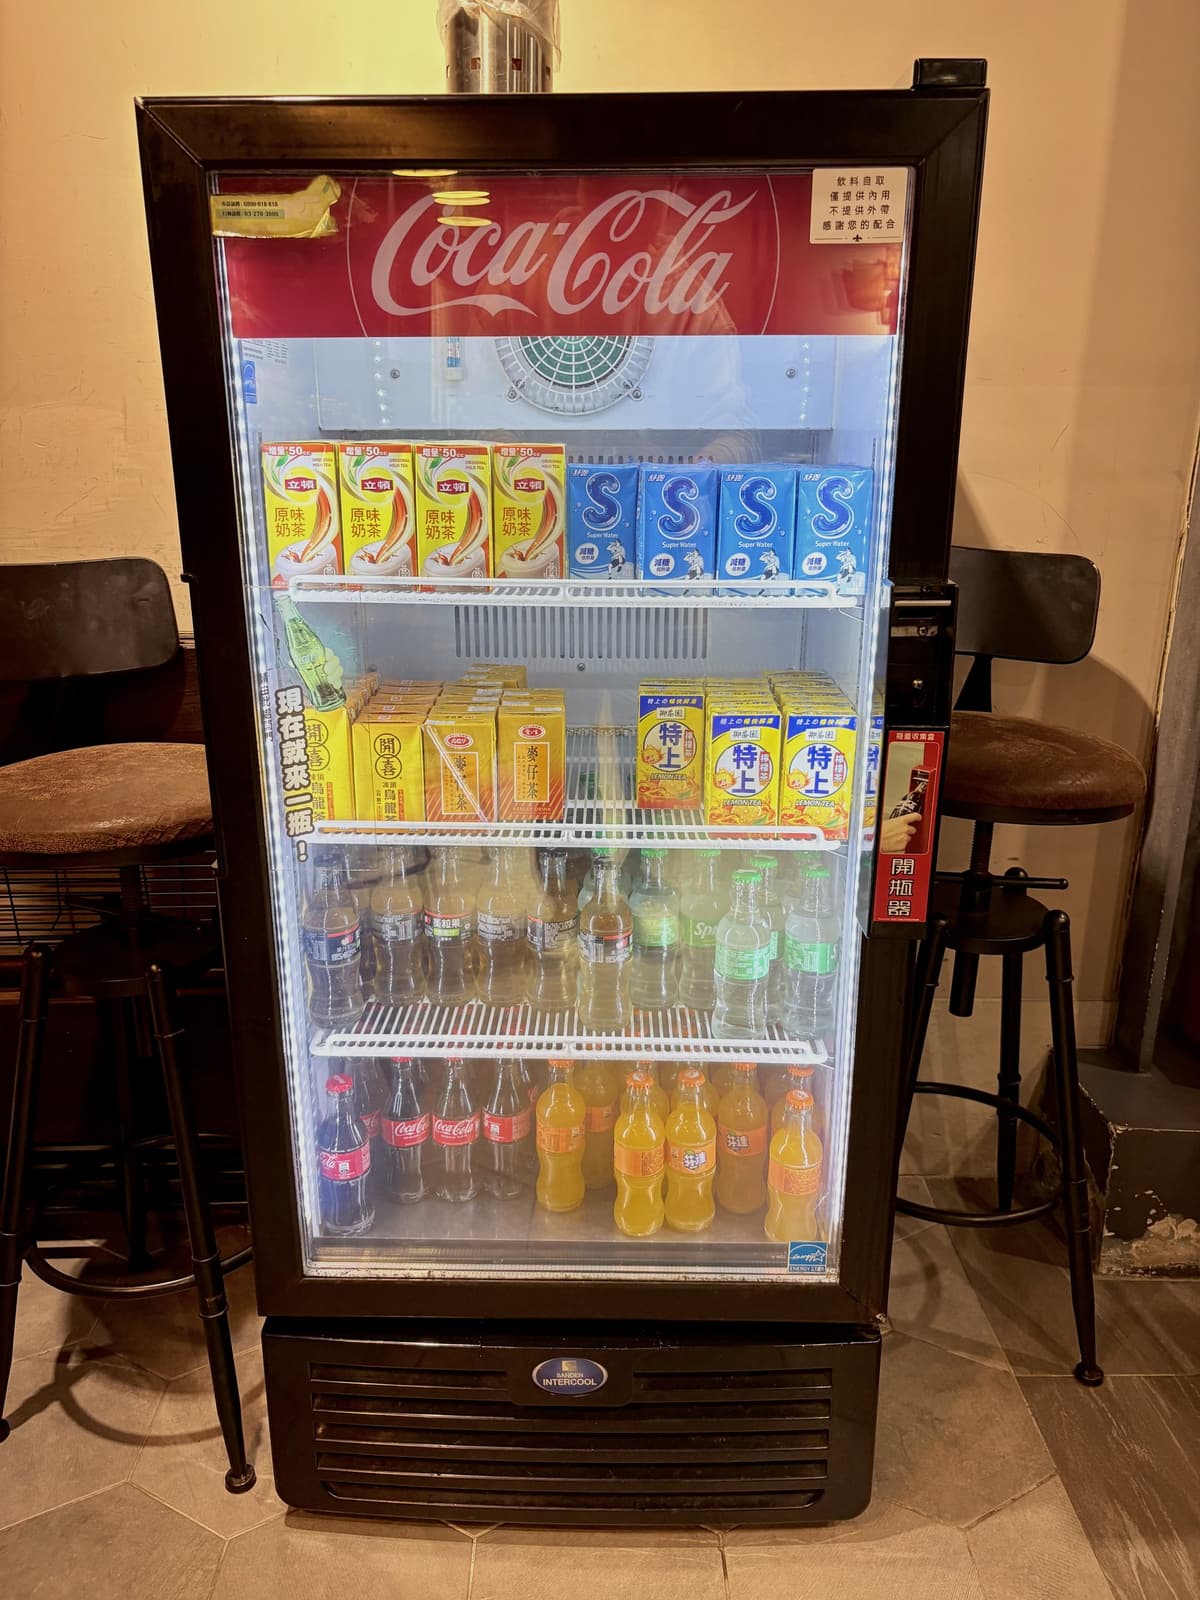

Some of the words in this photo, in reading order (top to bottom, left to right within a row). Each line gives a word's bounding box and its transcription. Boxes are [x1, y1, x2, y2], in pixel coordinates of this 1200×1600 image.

[837, 175, 885, 187] 飲料自取
[830, 190, 890, 202] 僅提供內用
[829, 204, 890, 216] 不提供外帶
[822, 218, 896, 231] 感謝您的配合
[371, 190, 758, 317] Coca-Cola
[286, 480, 315, 489] 立頓
[363, 480, 392, 490] 立頓
[439, 482, 466, 492] 立頓
[515, 480, 543, 491] 立頓
[274, 507, 305, 522] 原味
[350, 508, 381, 522] 原味
[425, 509, 456, 525] 原味
[502, 507, 531, 522] 原味
[275, 523, 306, 537] 奶茶
[351, 523, 382, 538] 奶茶
[426, 525, 456, 540] 奶茶
[502, 522, 531, 536] 奶茶
[658, 722, 683, 769] 特上
[731, 744, 758, 794] 特上
[805, 745, 832, 795] 特上
[887, 857, 915, 917] 開瓶器
[543, 1378, 597, 1386] INTERCOOL
